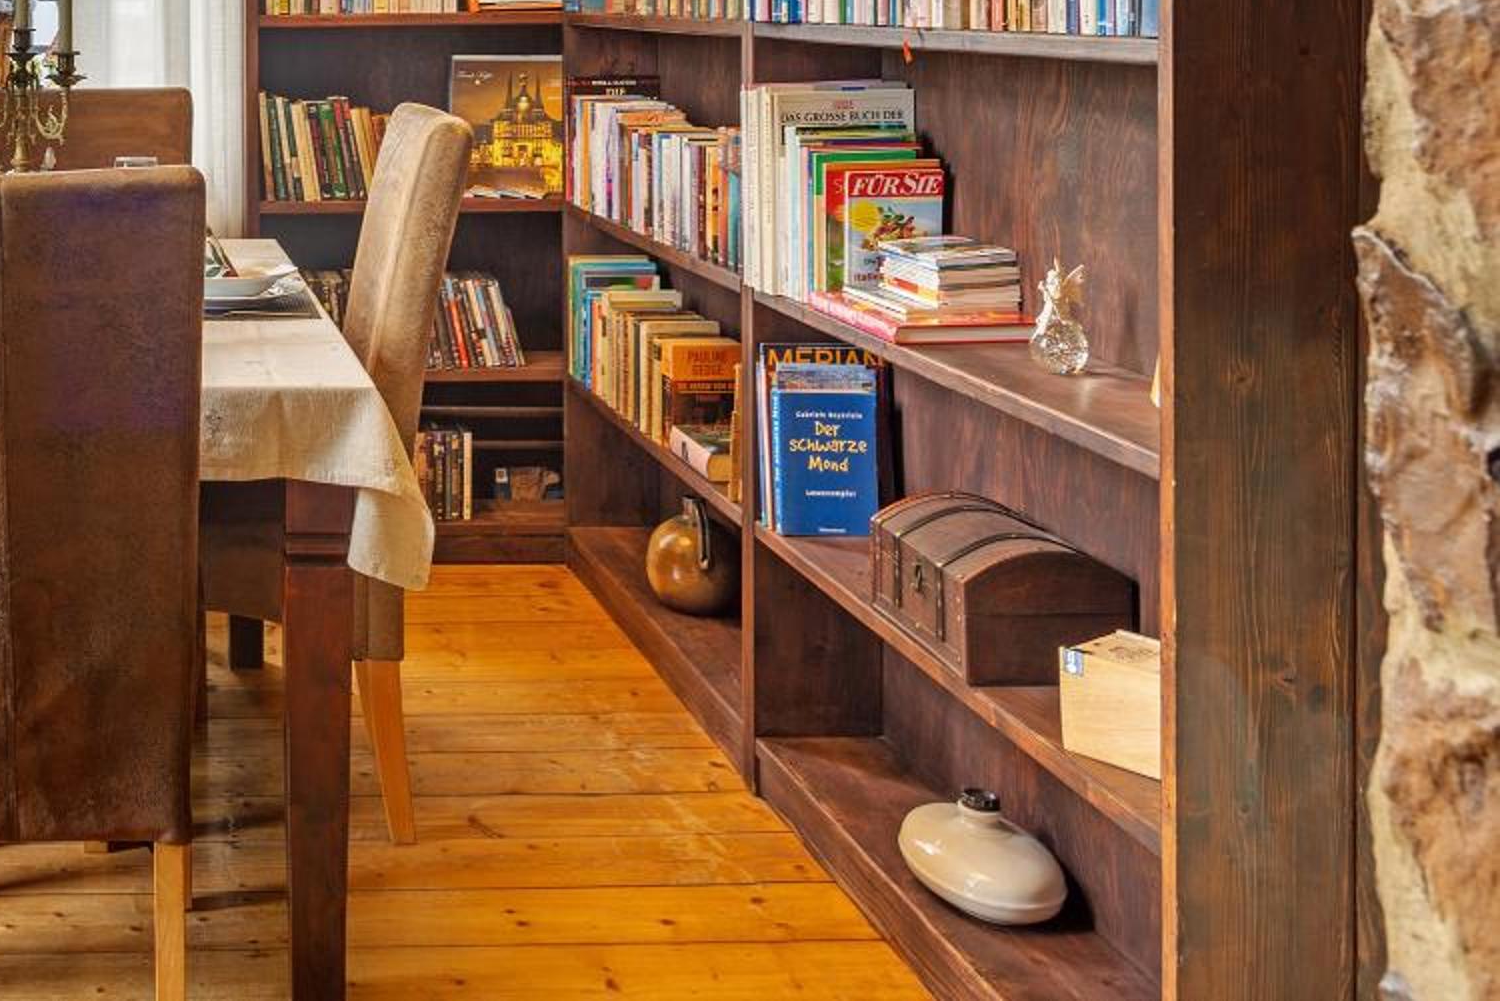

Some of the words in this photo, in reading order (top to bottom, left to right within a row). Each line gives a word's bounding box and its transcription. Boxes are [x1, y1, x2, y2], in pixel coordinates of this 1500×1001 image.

[803, 111, 846, 122] GROSSE
[850, 109, 880, 121] BUCH
[883, 109, 904, 120] DER
[850, 173, 900, 196] FÜR
[814, 420, 840, 436] Der
[808, 455, 849, 472] Mond
